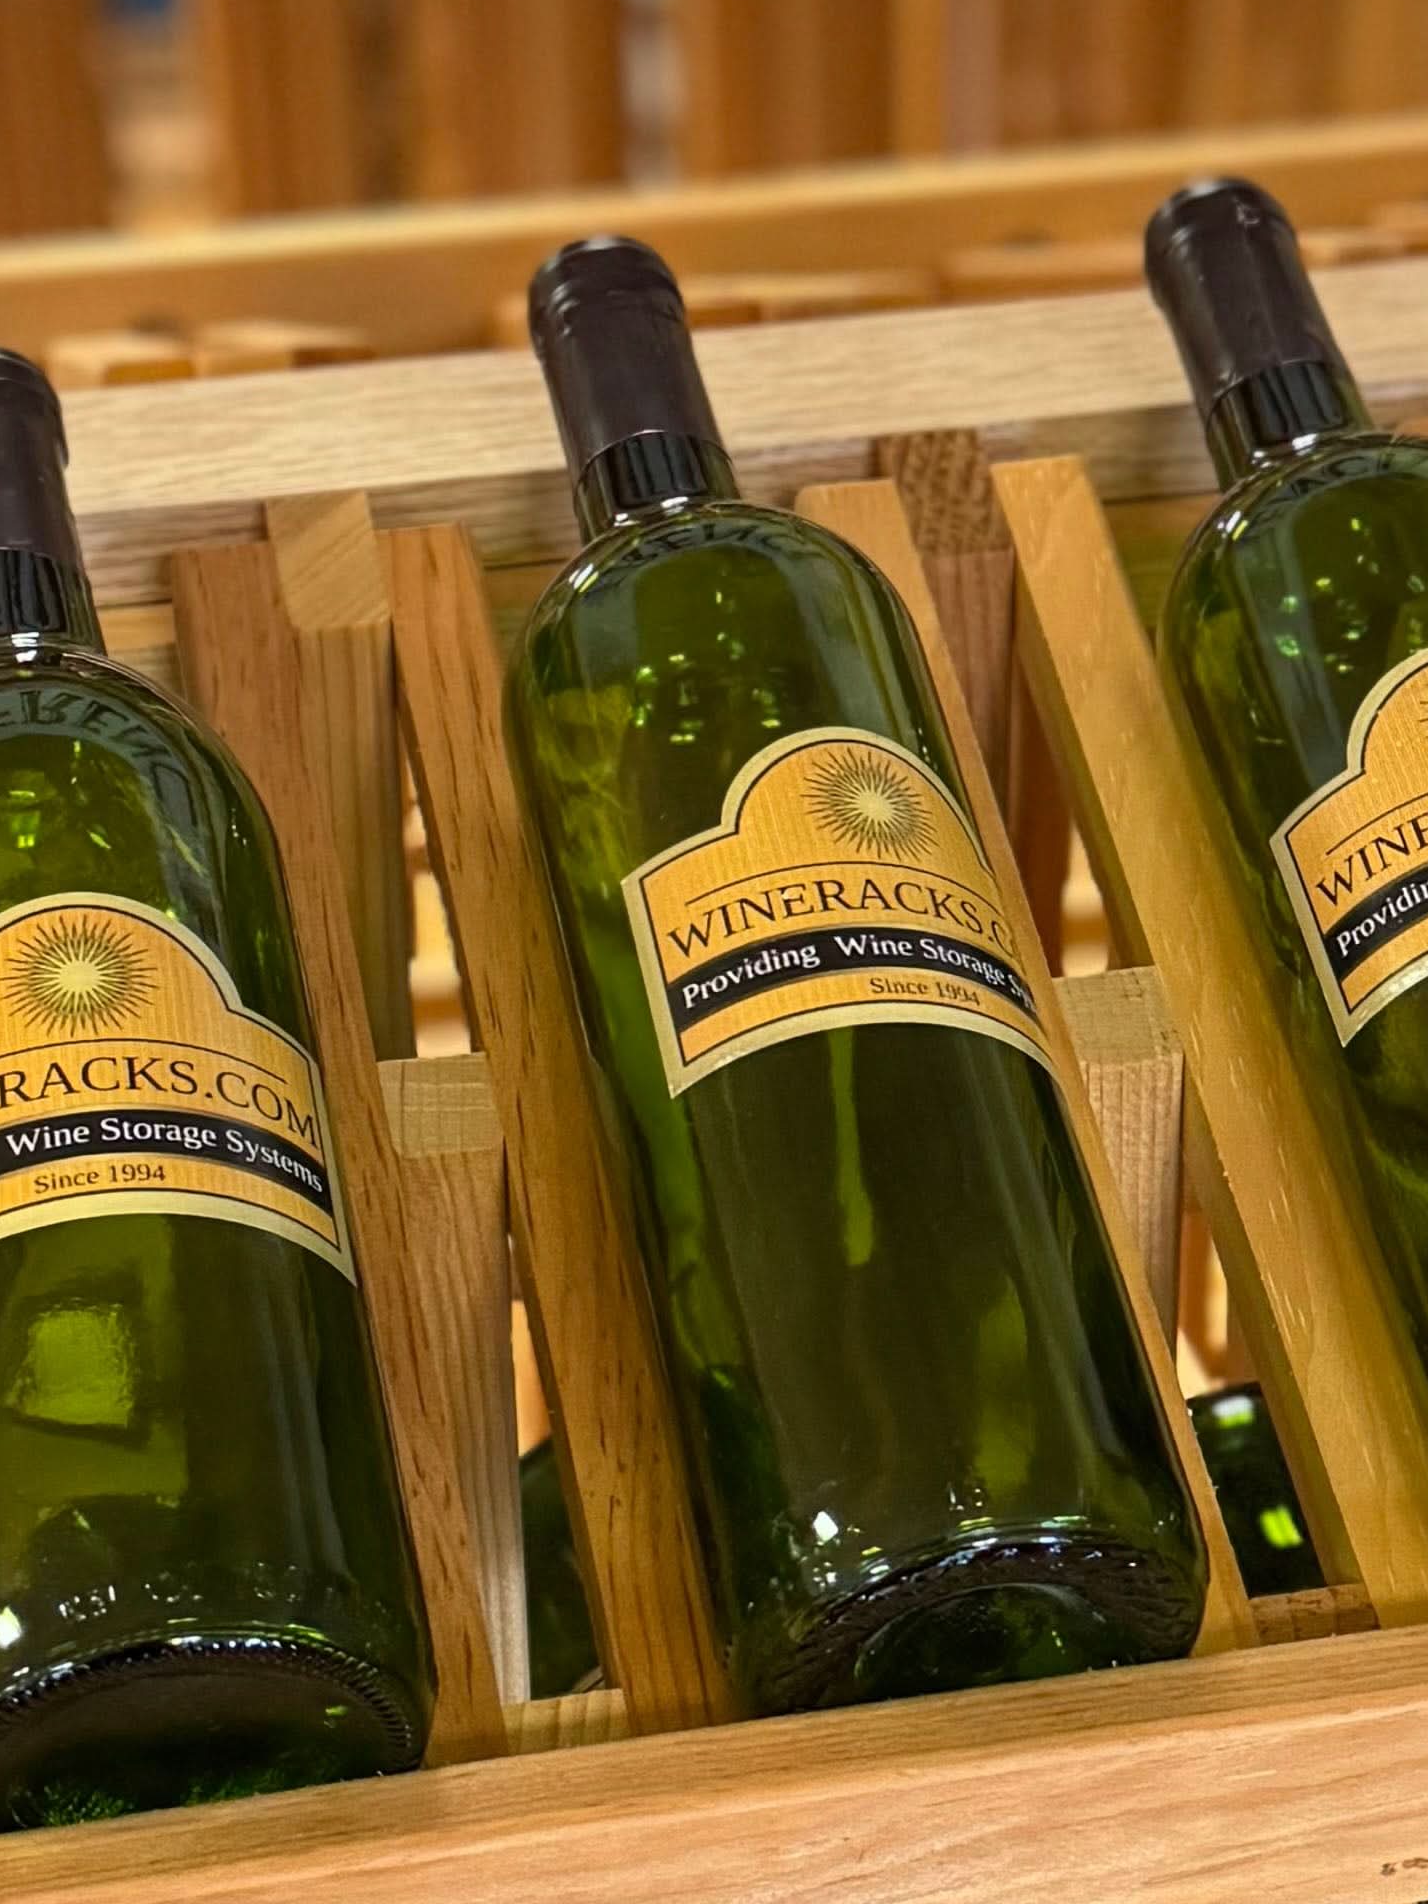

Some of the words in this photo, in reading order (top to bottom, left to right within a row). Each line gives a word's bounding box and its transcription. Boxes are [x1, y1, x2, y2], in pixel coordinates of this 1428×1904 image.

[681, 944, 820, 1008] Providing
[834, 935, 914, 958] Wine
[919, 938, 1006, 986] Storage
[870, 977, 928, 996] Since
[6, 1122, 90, 1157] Wine
[100, 1116, 218, 1150] Storage
[226, 1129, 324, 1194] Systems
[33, 1169, 100, 1195] Since
[108, 1163, 165, 1184] 1994
